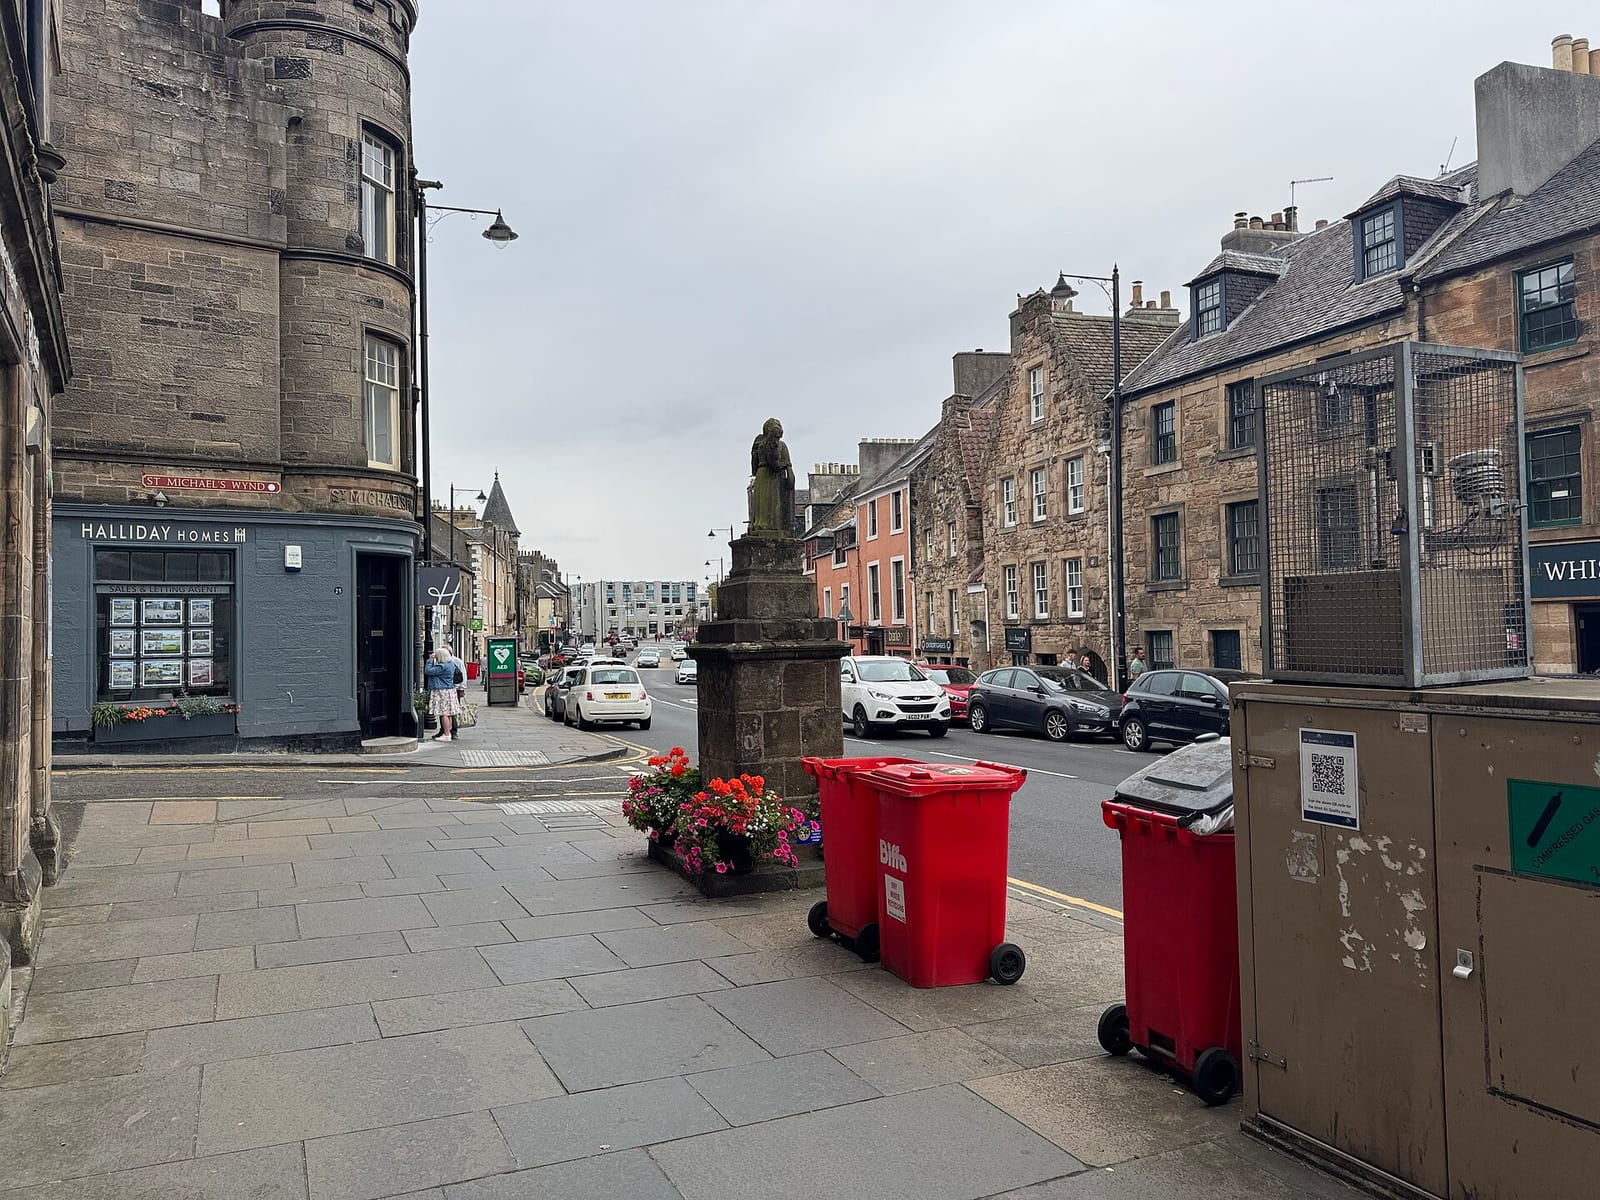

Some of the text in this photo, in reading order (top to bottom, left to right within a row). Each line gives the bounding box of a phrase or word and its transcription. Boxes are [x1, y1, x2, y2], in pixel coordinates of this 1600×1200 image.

[146, 477, 266, 491] ST MICHAEL'S WYND
[81, 523, 229, 543] HALLIDAY HOMES
[1544, 559, 1600, 581] WHI
[109, 585, 218, 593] SALES & LETTING AGENT
[880, 838, 908, 873] Biffa
[1532, 823, 1583, 868] COMPRESSED
